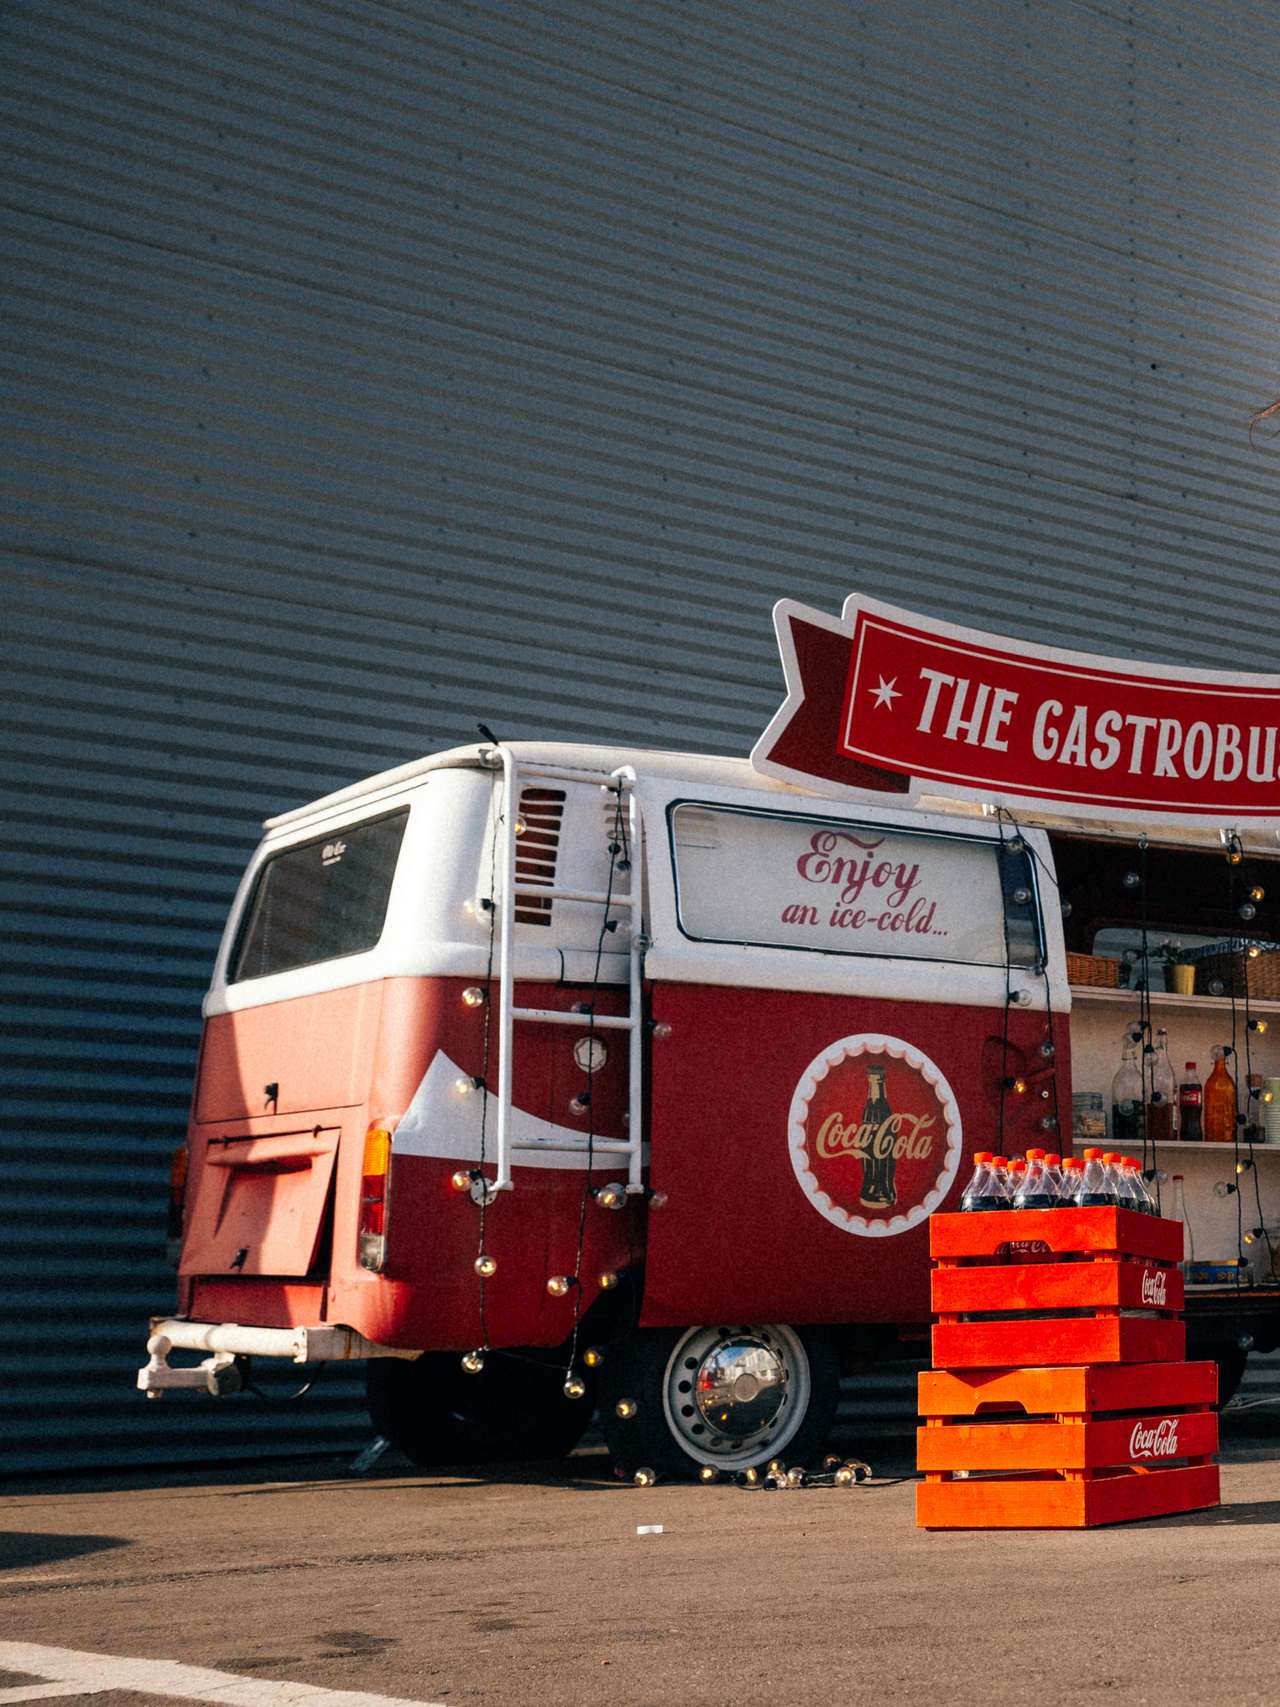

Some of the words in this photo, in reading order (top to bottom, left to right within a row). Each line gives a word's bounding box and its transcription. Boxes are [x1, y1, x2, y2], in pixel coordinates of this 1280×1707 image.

[916, 667, 1020, 753] THE
[796, 830, 922, 908] Enjoy
[780, 902, 822, 926] an
[828, 897, 949, 937] ice-cold...
[816, 1111, 937, 1160] Coca-Cola
[1129, 1418, 1180, 1458] Coca-Cola
